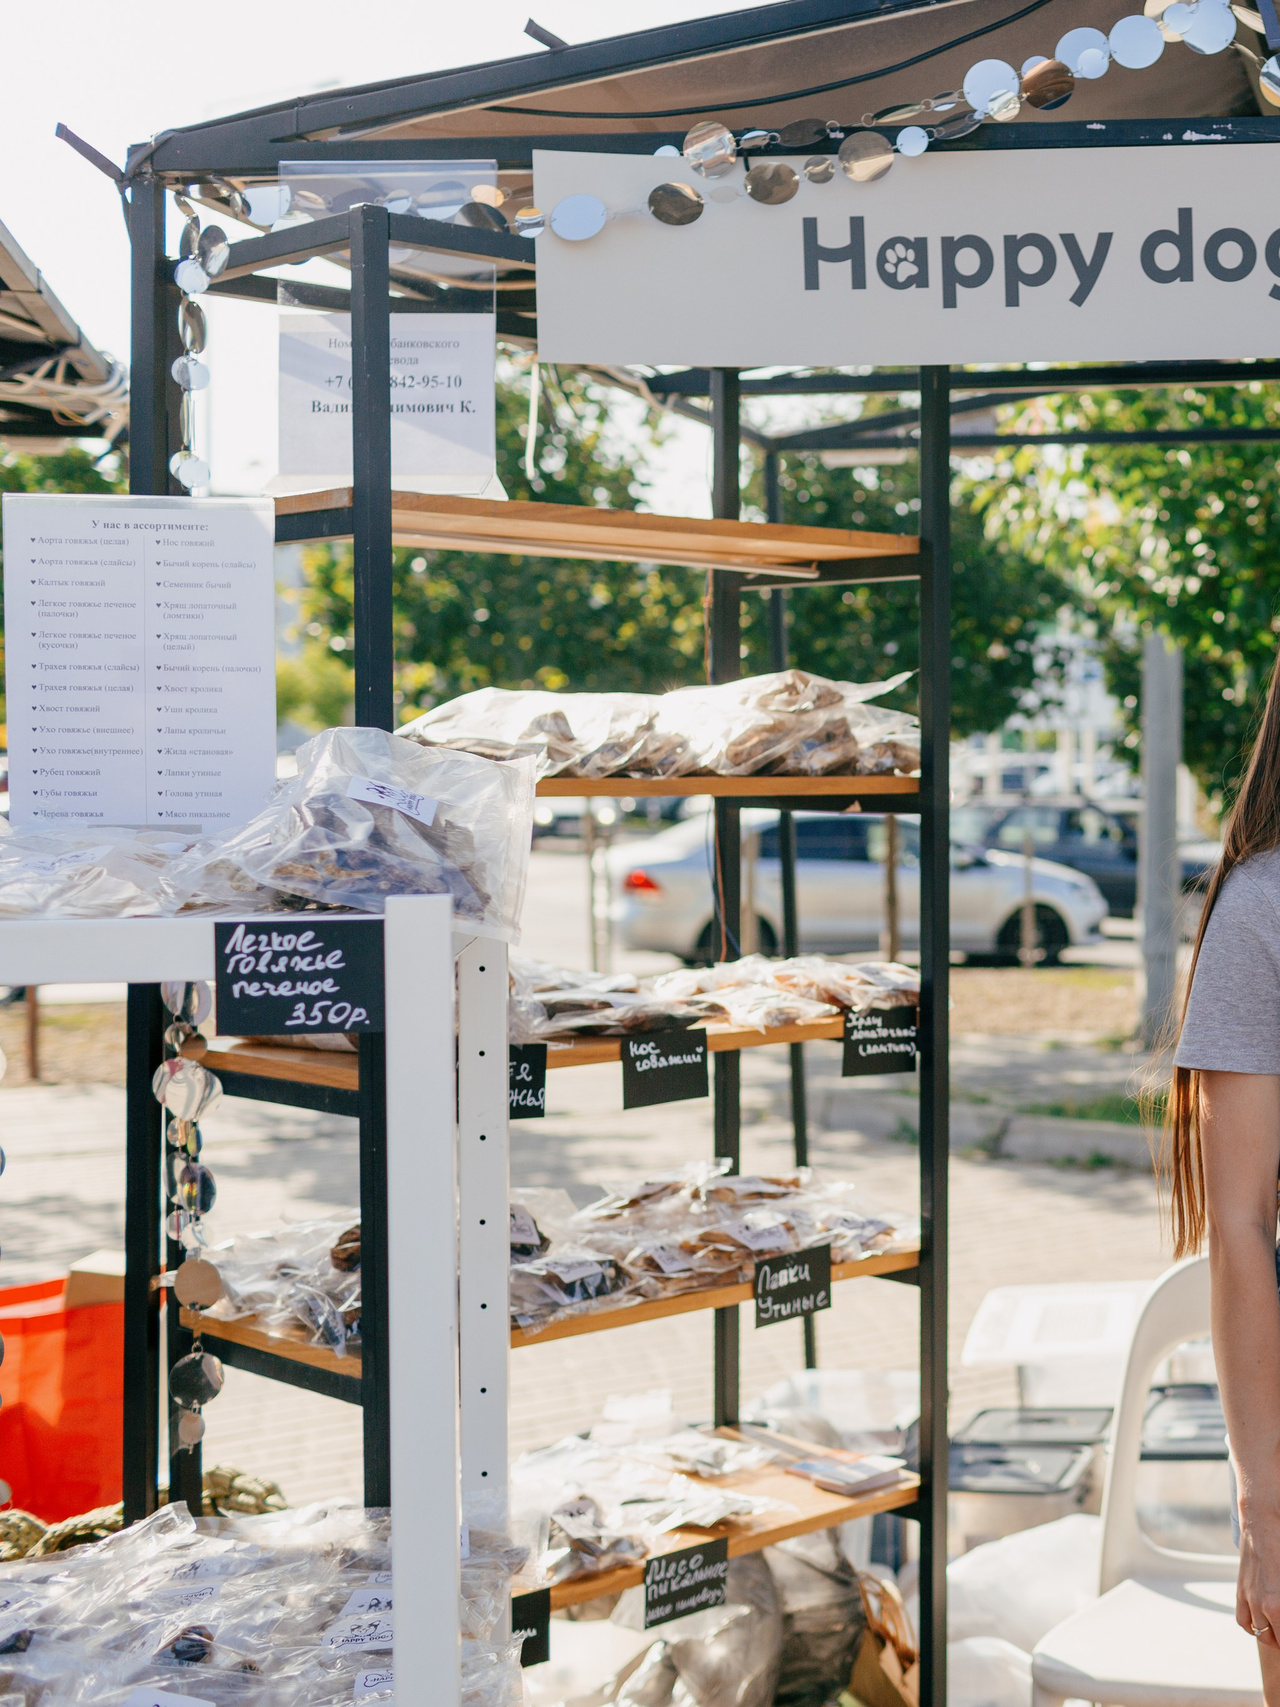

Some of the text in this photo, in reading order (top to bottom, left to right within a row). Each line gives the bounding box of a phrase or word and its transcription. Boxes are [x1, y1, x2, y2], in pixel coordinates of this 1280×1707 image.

[800, 215, 1114, 309] Happy
[390, 337, 460, 350] банковского
[324, 376, 343, 388] +7
[390, 374, 462, 389] 842-95-10
[460, 400, 477, 414] К.
[91, 520, 210, 534] У нас в ассортименте:
[37, 536, 63, 546] Аорта
[100, 536, 130, 546] (целая)
[162, 538, 215, 547] Нос говяжий
[37, 557, 63, 567] Аорта
[100, 557, 136, 567] (слайсы)
[162, 560, 257, 570] Бычий корень (слайсы)
[37, 577, 106, 586] Калтык говяжий
[163, 580, 232, 589] Семенник бычий
[37, 599, 67, 607] Легкое
[163, 601, 237, 611] Хрящ лопаточный
[37, 609, 79, 619] (палочки)
[162, 611, 204, 621] (ломтики)
[38, 630, 67, 638] Легкое
[163, 632, 238, 643] Хрящ лопаточный
[37, 640, 79, 650] (кусочки)
[162, 642, 196, 652] (целый)
[38, 662, 67, 672] Трахея
[104, 662, 140, 672] (слайсы)
[163, 664, 262, 674] Бычий корень (палочки)
[38, 682, 67, 692] Трахея
[104, 682, 134, 692] (целая)
[163, 684, 223, 695] Хвост кролика
[38, 703, 101, 712] Хвост говяжий
[163, 705, 218, 715] Уши кролика
[38, 725, 56, 733] Ухо
[93, 725, 135, 735] (внешнее)
[163, 726, 227, 736] Лапы кроличьи
[39, 746, 144, 756] Ухо говяжье(внутреннее)
[163, 747, 234, 756] Жила «становая»
[39, 767, 101, 777] Рубец говяжий
[164, 769, 222, 779] Лапки утиные
[39, 787, 62, 798] Губы
[164, 789, 223, 799] Голова утиная
[40, 809, 69, 819] Черева
[164, 810, 187, 818] Мясо
[224, 923, 325, 954] Легкое
[232, 977, 341, 998] печеное
[284, 1000, 370, 1030] 350р.
